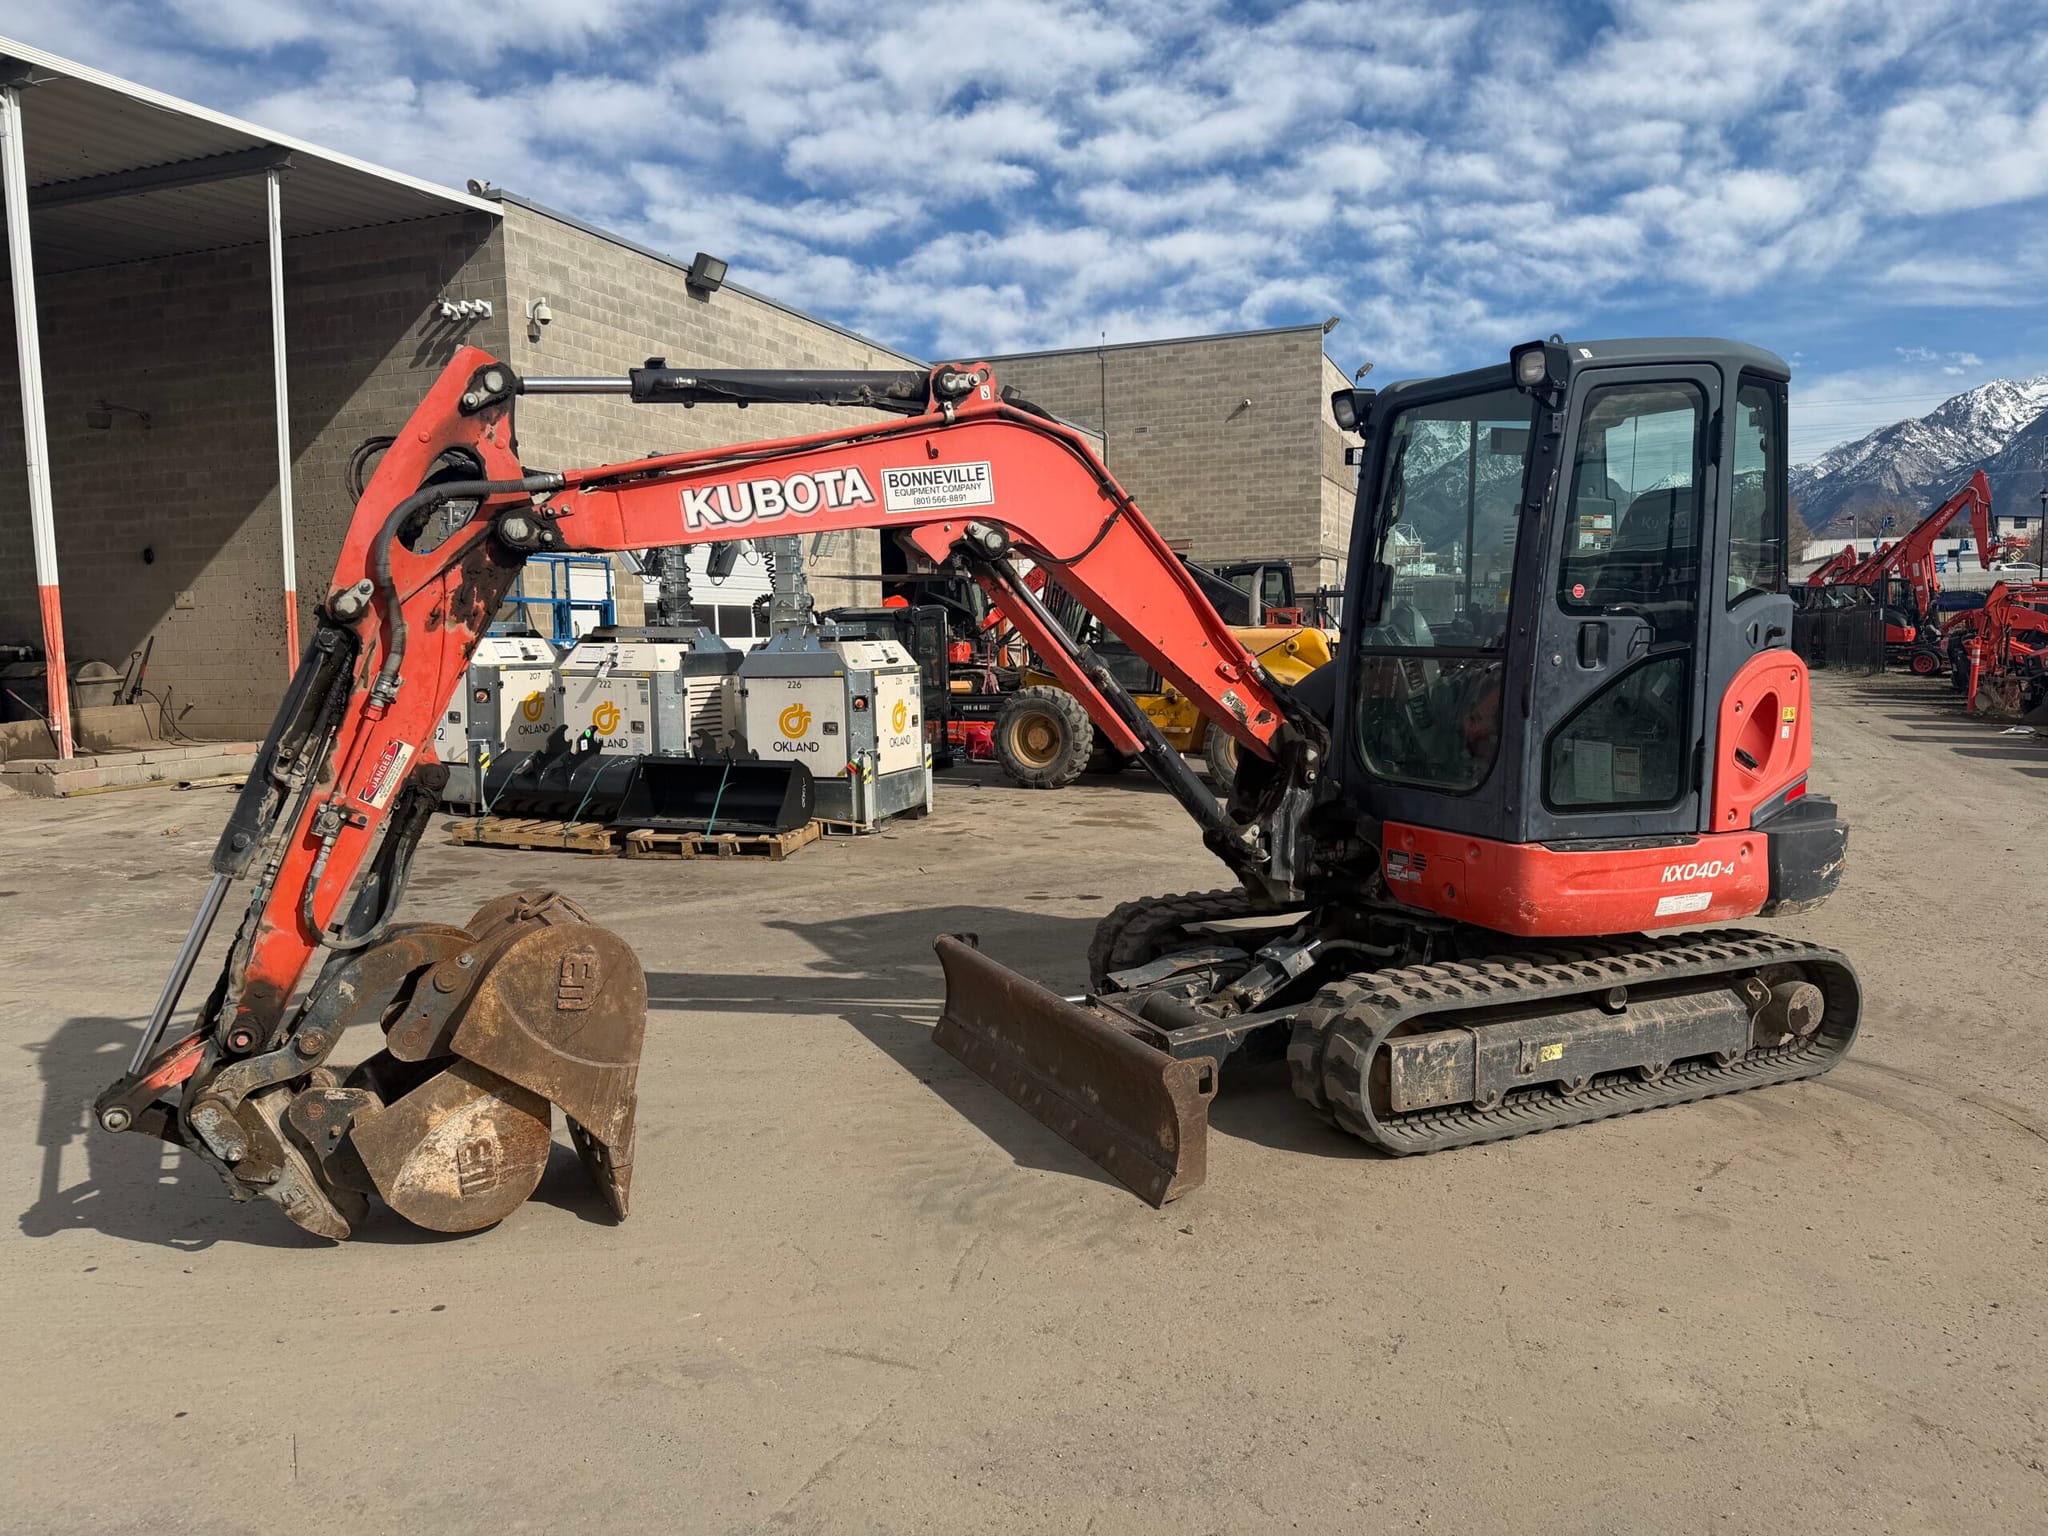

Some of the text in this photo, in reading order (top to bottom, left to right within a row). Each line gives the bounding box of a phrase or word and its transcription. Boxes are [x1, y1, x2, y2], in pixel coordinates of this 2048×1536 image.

[888, 466, 986, 488] BONNEVILLE
[894, 482, 982, 498] EQUIPMENT COMPANY
[681, 468, 875, 528] KUBOTA
[913, 493, 967, 506] (801) 566-8891
[787, 680, 802, 689] 226
[518, 723, 551, 736] OKLAND
[595, 737, 628, 749] LAND
[772, 741, 820, 753] OKLAND
[889, 734, 911, 748] OKLAND
[1660, 860, 1736, 883] KX040-4
